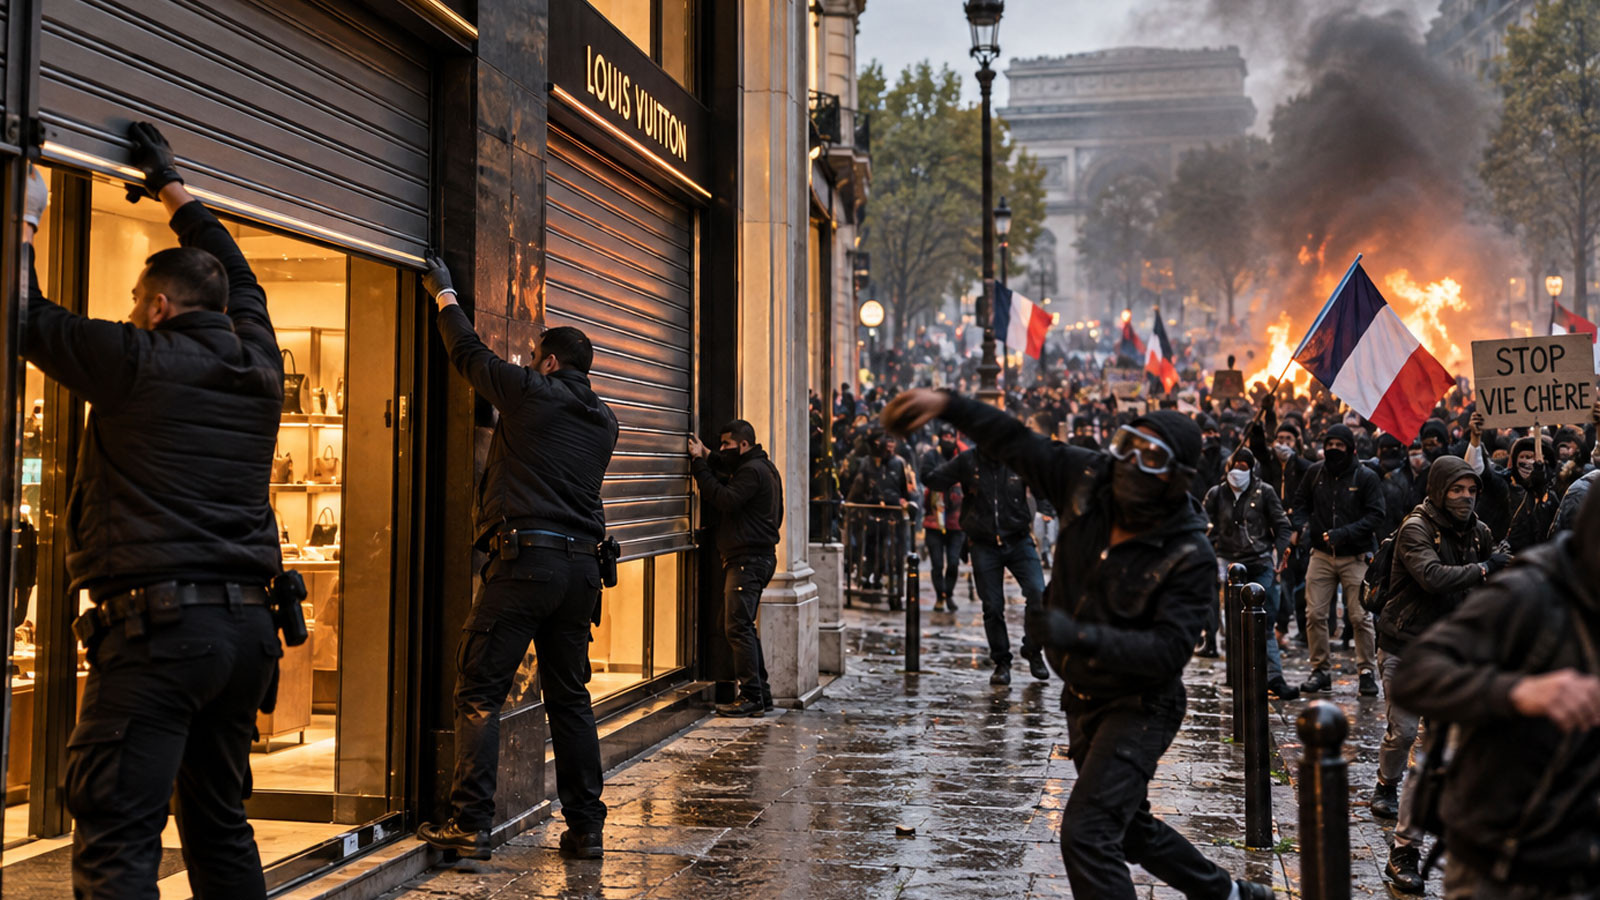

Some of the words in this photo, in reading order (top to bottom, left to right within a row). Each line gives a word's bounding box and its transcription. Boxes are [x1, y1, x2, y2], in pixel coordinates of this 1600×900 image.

[587, 45, 631, 120] LOUIS
[635, 84, 687, 162] VUITTON
[1496, 344, 1565, 376] STOP
[1479, 387, 1517, 415] VIE
[1523, 378, 1592, 413] CHÈRE
